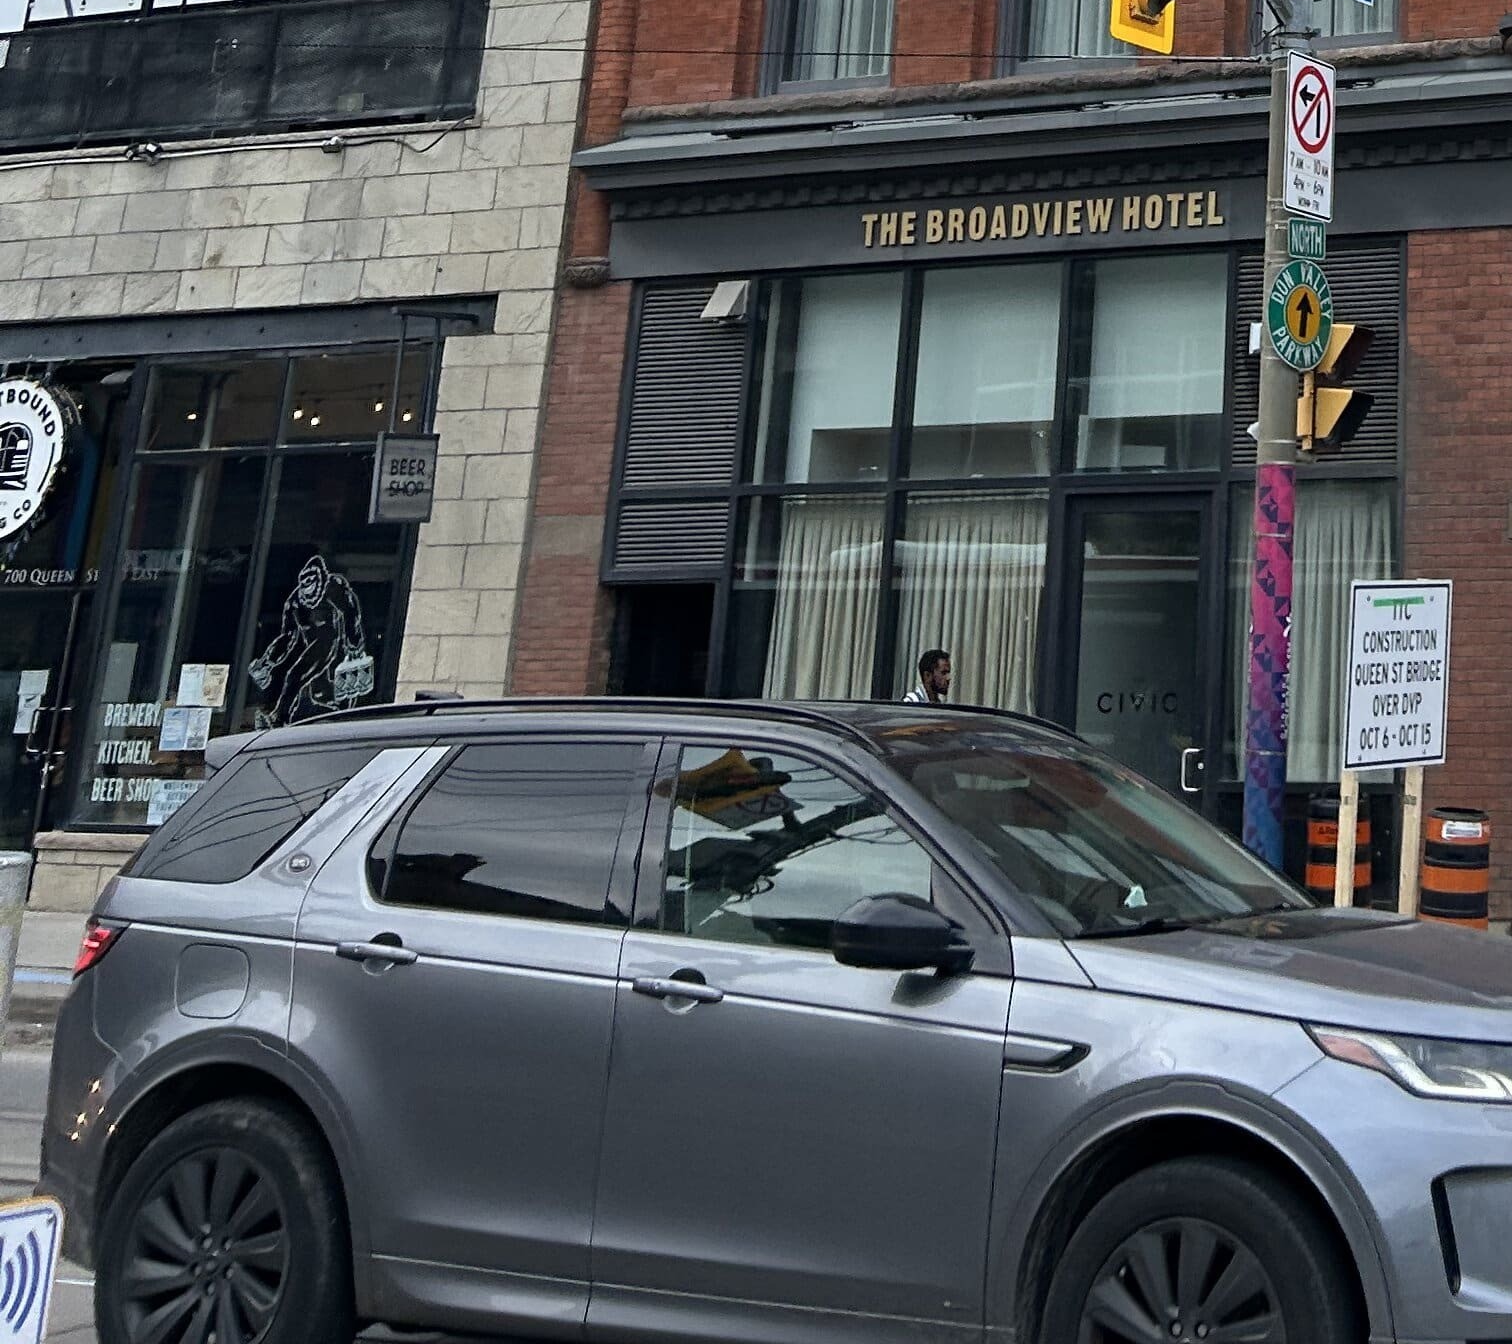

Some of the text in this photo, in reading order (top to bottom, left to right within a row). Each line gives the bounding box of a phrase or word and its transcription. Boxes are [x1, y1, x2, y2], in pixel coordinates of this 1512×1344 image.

[862, 190, 1224, 247] THE BROADVIEW HOTEL
[1291, 223, 1322, 255] NORTH
[1271, 263, 1332, 320] DON VALLEY
[1272, 326, 1324, 367] PARKWAY
[390, 458, 426, 476] BEER
[388, 480, 424, 497] SHOP
[4, 568, 27, 584] 700
[30, 568, 76, 586] QUEEN
[1391, 599, 1413, 620] TTC
[1363, 629, 1437, 653] CONSTRUCTION
[1355, 659, 1442, 686] QUEEN ST BRIDGE
[1097, 693, 1178, 714] CIVIC
[1372, 692, 1423, 717] OVER DVP
[1360, 727, 1380, 750] OCT
[1382, 726, 1390, 748] 6
[1399, 724, 1419, 747] OCT
[1421, 723, 1431, 746] 15
[91, 777, 124, 802] BEER
